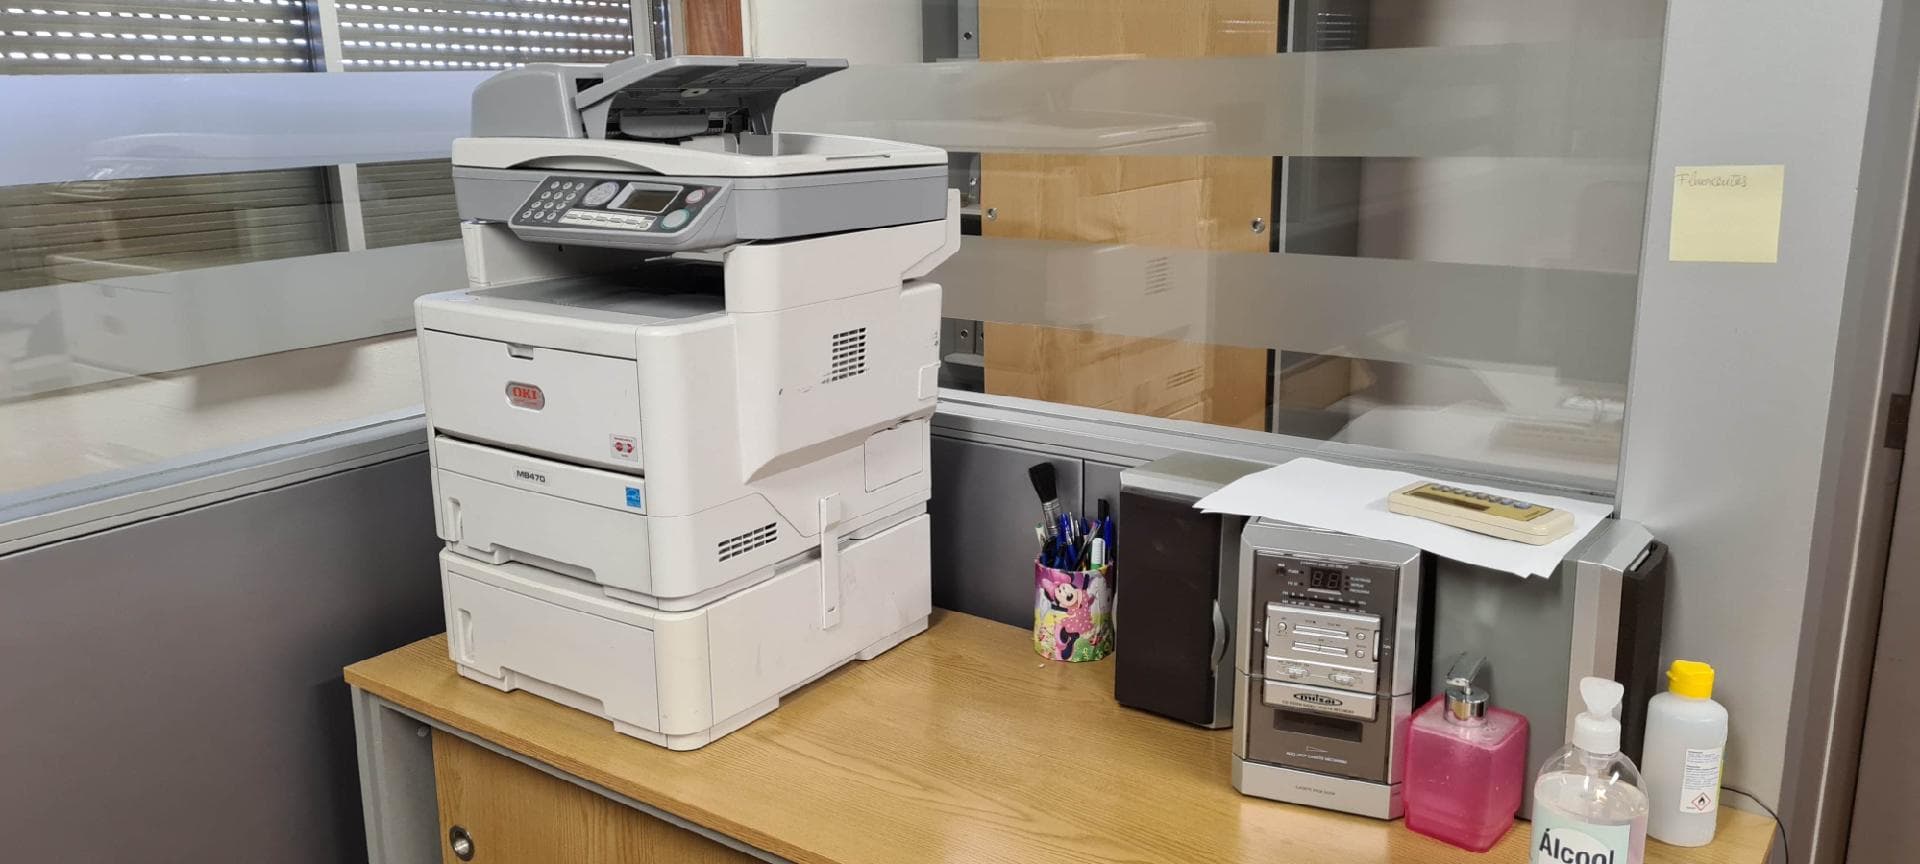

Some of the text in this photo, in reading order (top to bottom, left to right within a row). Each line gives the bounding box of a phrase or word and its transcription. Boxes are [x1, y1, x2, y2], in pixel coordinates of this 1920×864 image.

[512, 387, 537, 400] OKI
[516, 470, 546, 484] MB470
[1539, 828, 1615, 864] Álcool
